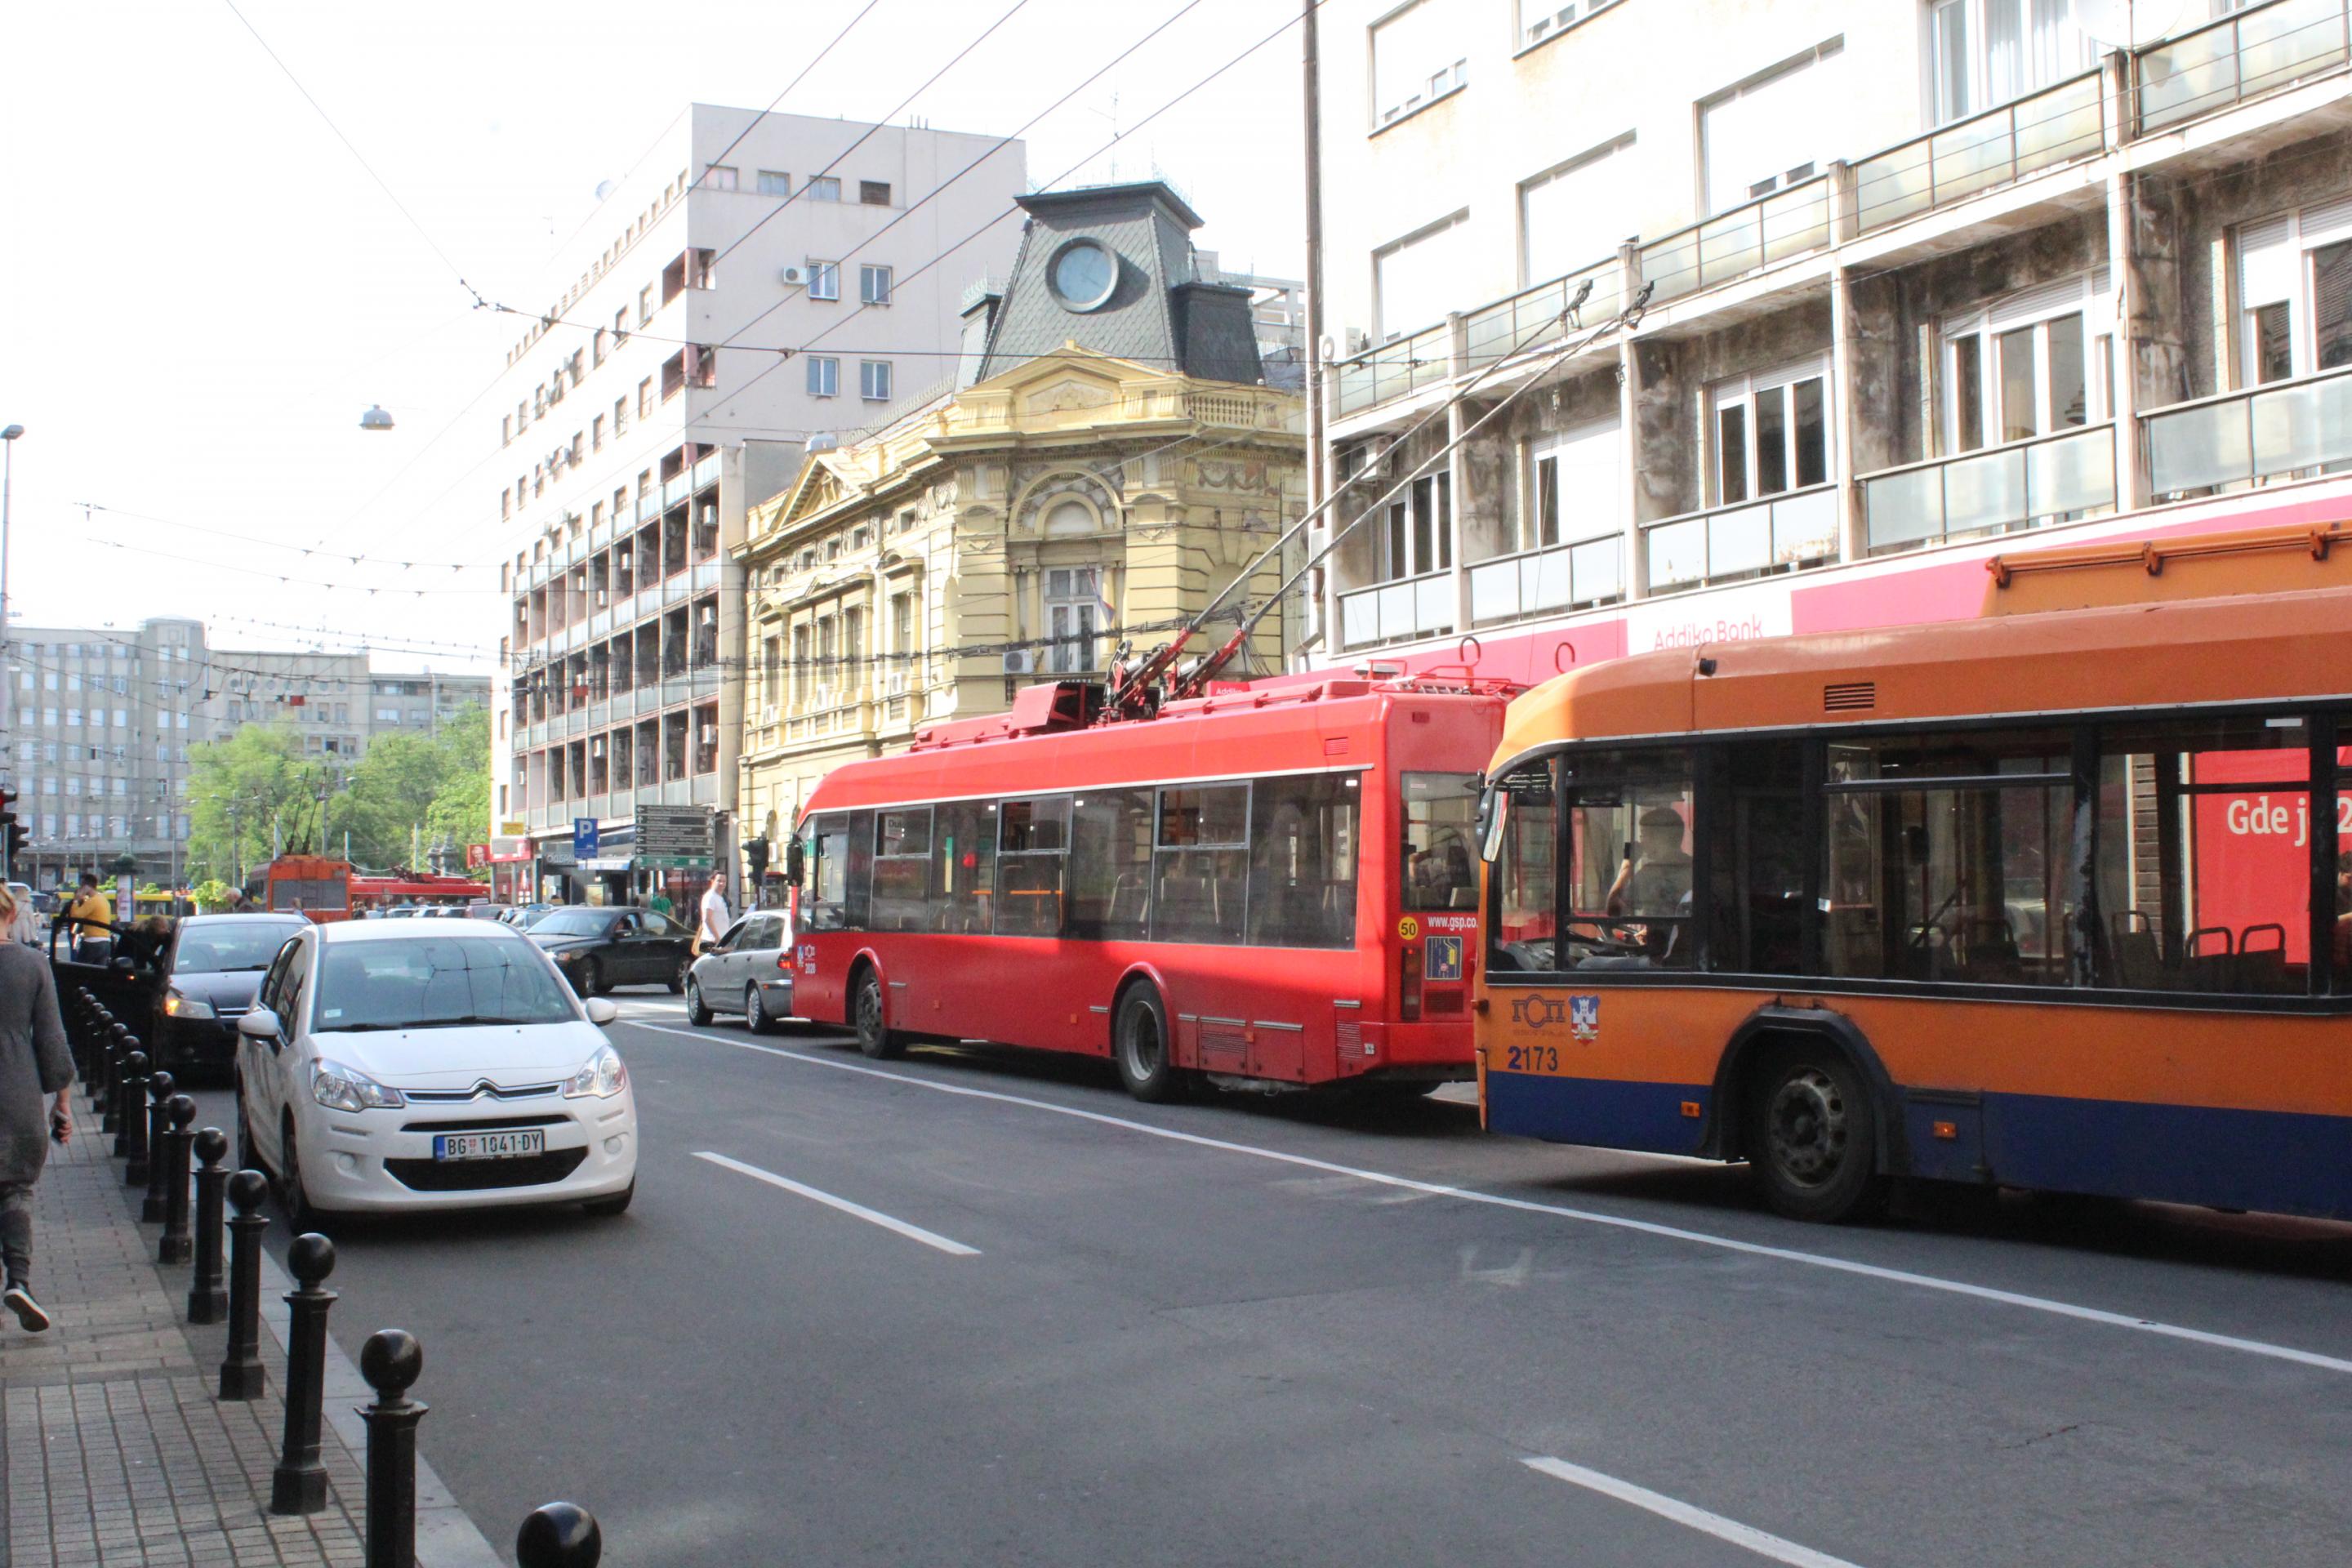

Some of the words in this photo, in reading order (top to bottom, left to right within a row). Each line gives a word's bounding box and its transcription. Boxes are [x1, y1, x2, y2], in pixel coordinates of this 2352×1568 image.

[1654, 623, 1713, 651] Addiko
[1717, 613, 1762, 643] Bank
[579, 820, 593, 839] P
[2227, 796, 2289, 835] Gde
[2294, 797, 2306, 847] j
[1401, 922, 1416, 936] 50
[1428, 916, 1478, 931] www.gsp.co.
[1508, 1045, 1558, 1071] 2173
[448, 1138, 466, 1155] BG
